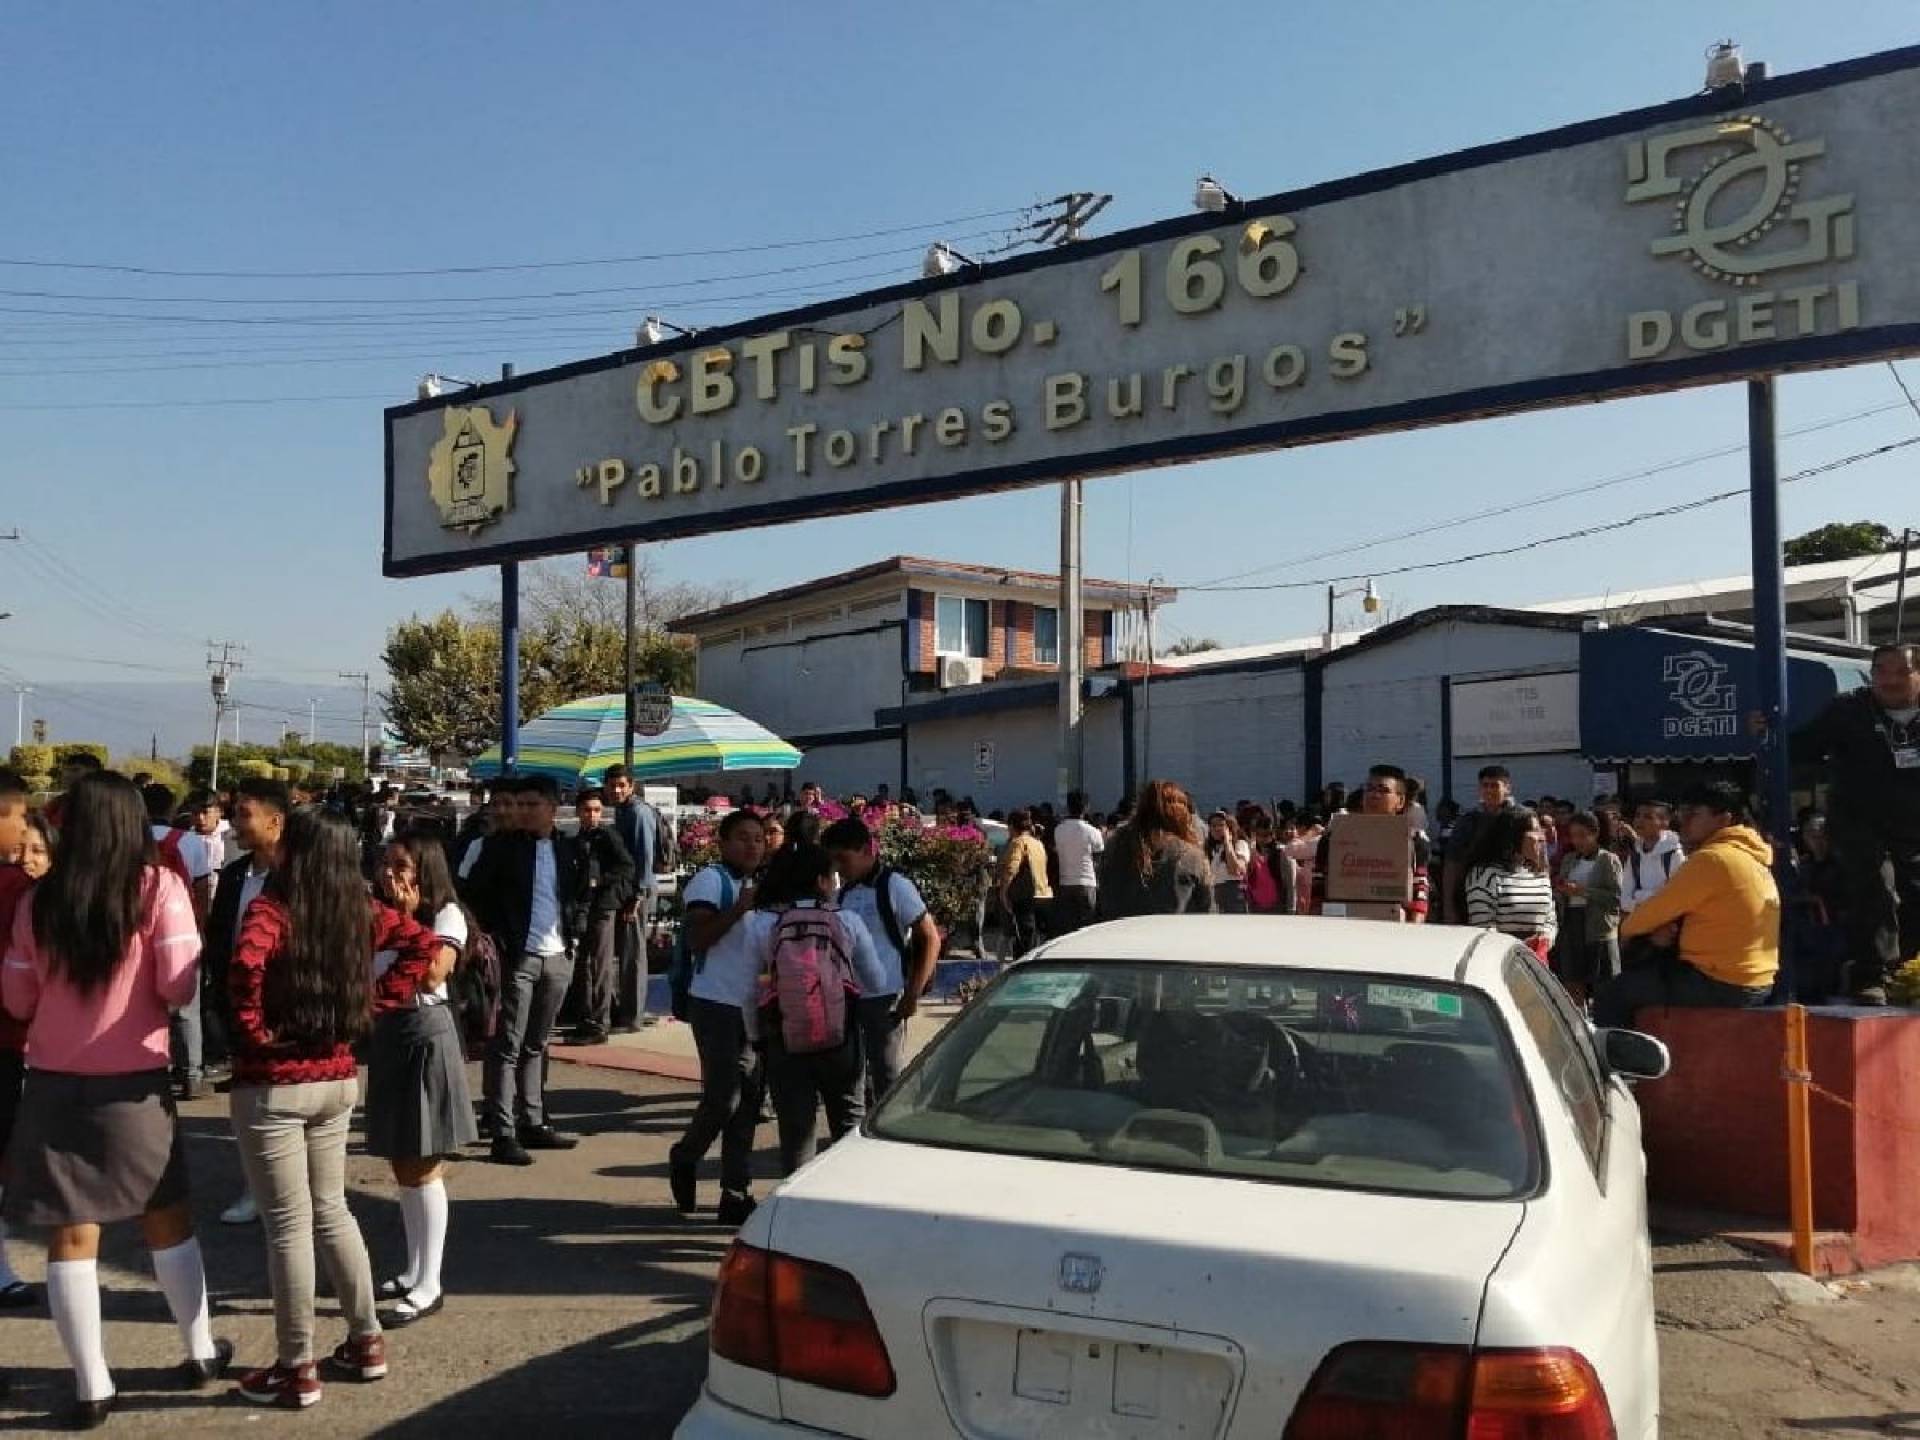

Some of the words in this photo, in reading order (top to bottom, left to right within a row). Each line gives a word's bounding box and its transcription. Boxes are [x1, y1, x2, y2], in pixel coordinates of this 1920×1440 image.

[903, 292, 1057, 371] No.
[1101, 215, 1304, 326] 166
[1628, 279, 1860, 360] DGETI
[786, 400, 1015, 475] Torres
[1663, 714, 1737, 738] DGETI
